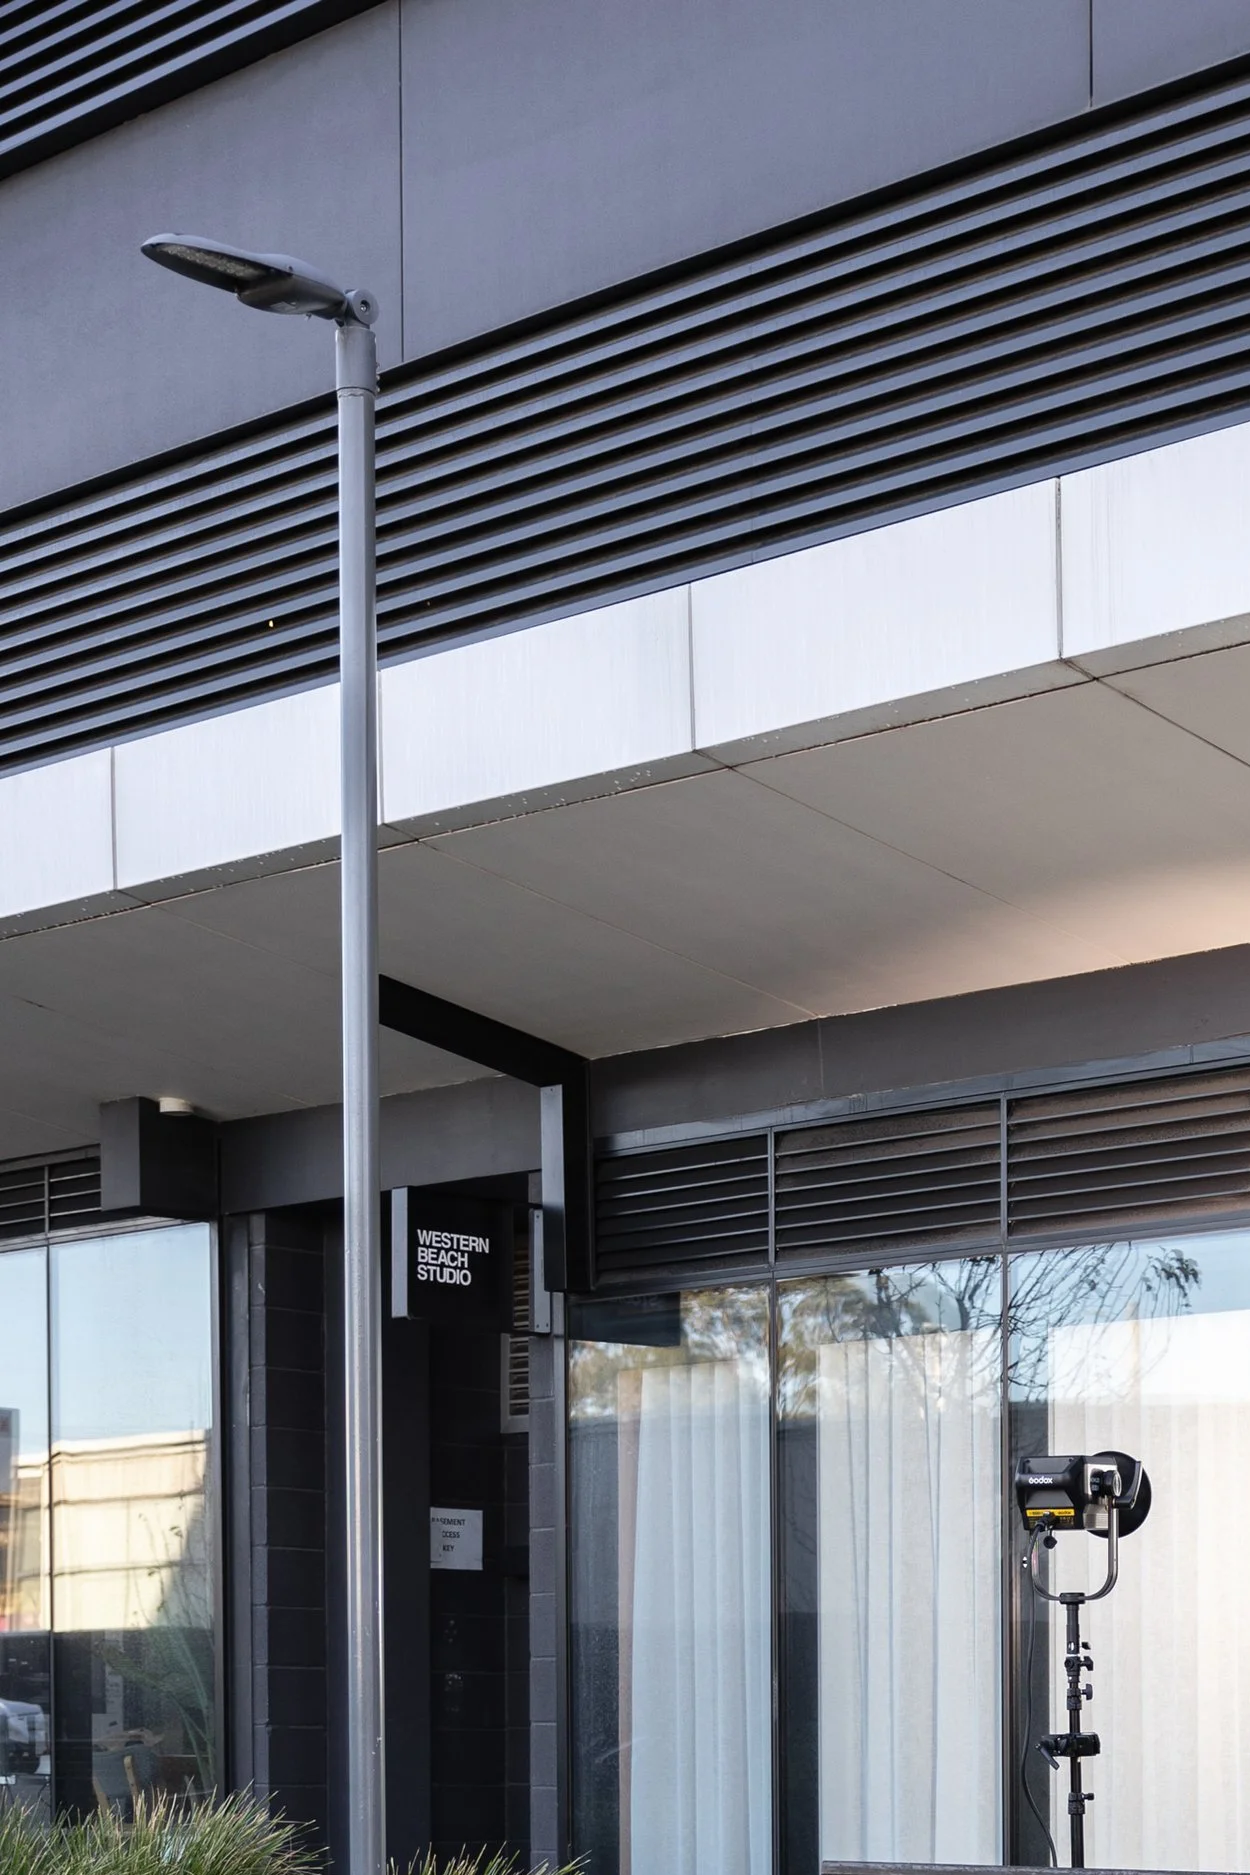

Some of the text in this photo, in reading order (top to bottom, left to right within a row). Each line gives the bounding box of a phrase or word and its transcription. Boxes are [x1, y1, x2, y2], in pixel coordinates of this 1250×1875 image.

[417, 1229, 489, 1253] WESTERN
[418, 1247, 468, 1268] BEACH
[417, 1264, 471, 1286] STUDIO
